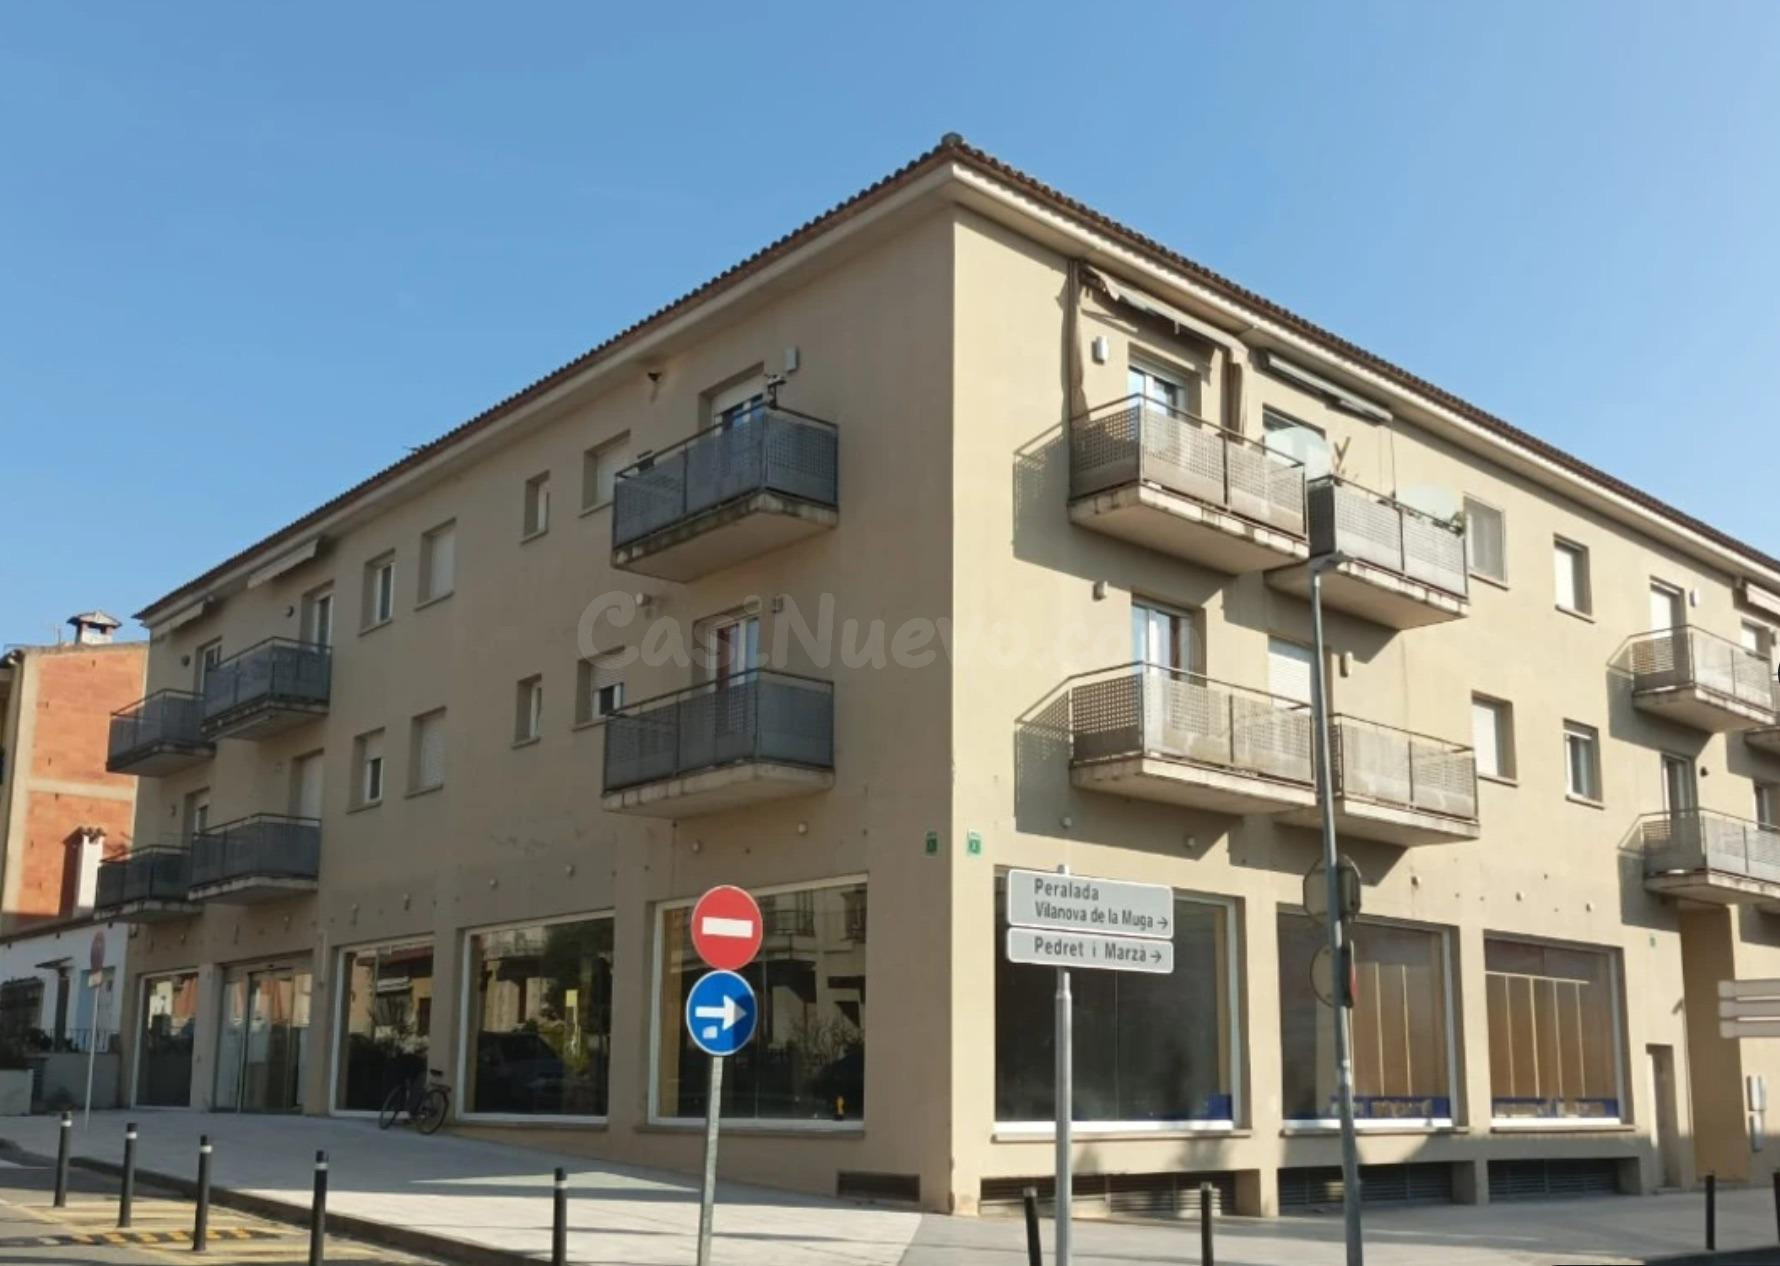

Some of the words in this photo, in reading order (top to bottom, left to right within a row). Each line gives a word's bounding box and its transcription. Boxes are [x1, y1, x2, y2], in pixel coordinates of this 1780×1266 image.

[1034, 878, 1099, 901] Peralada
[1035, 902, 1087, 922] Vilanova
[1091, 906, 1105, 923] de
[1108, 908, 1118, 925] la
[1122, 910, 1153, 931] Muga
[1034, 936, 1084, 957] Pedret
